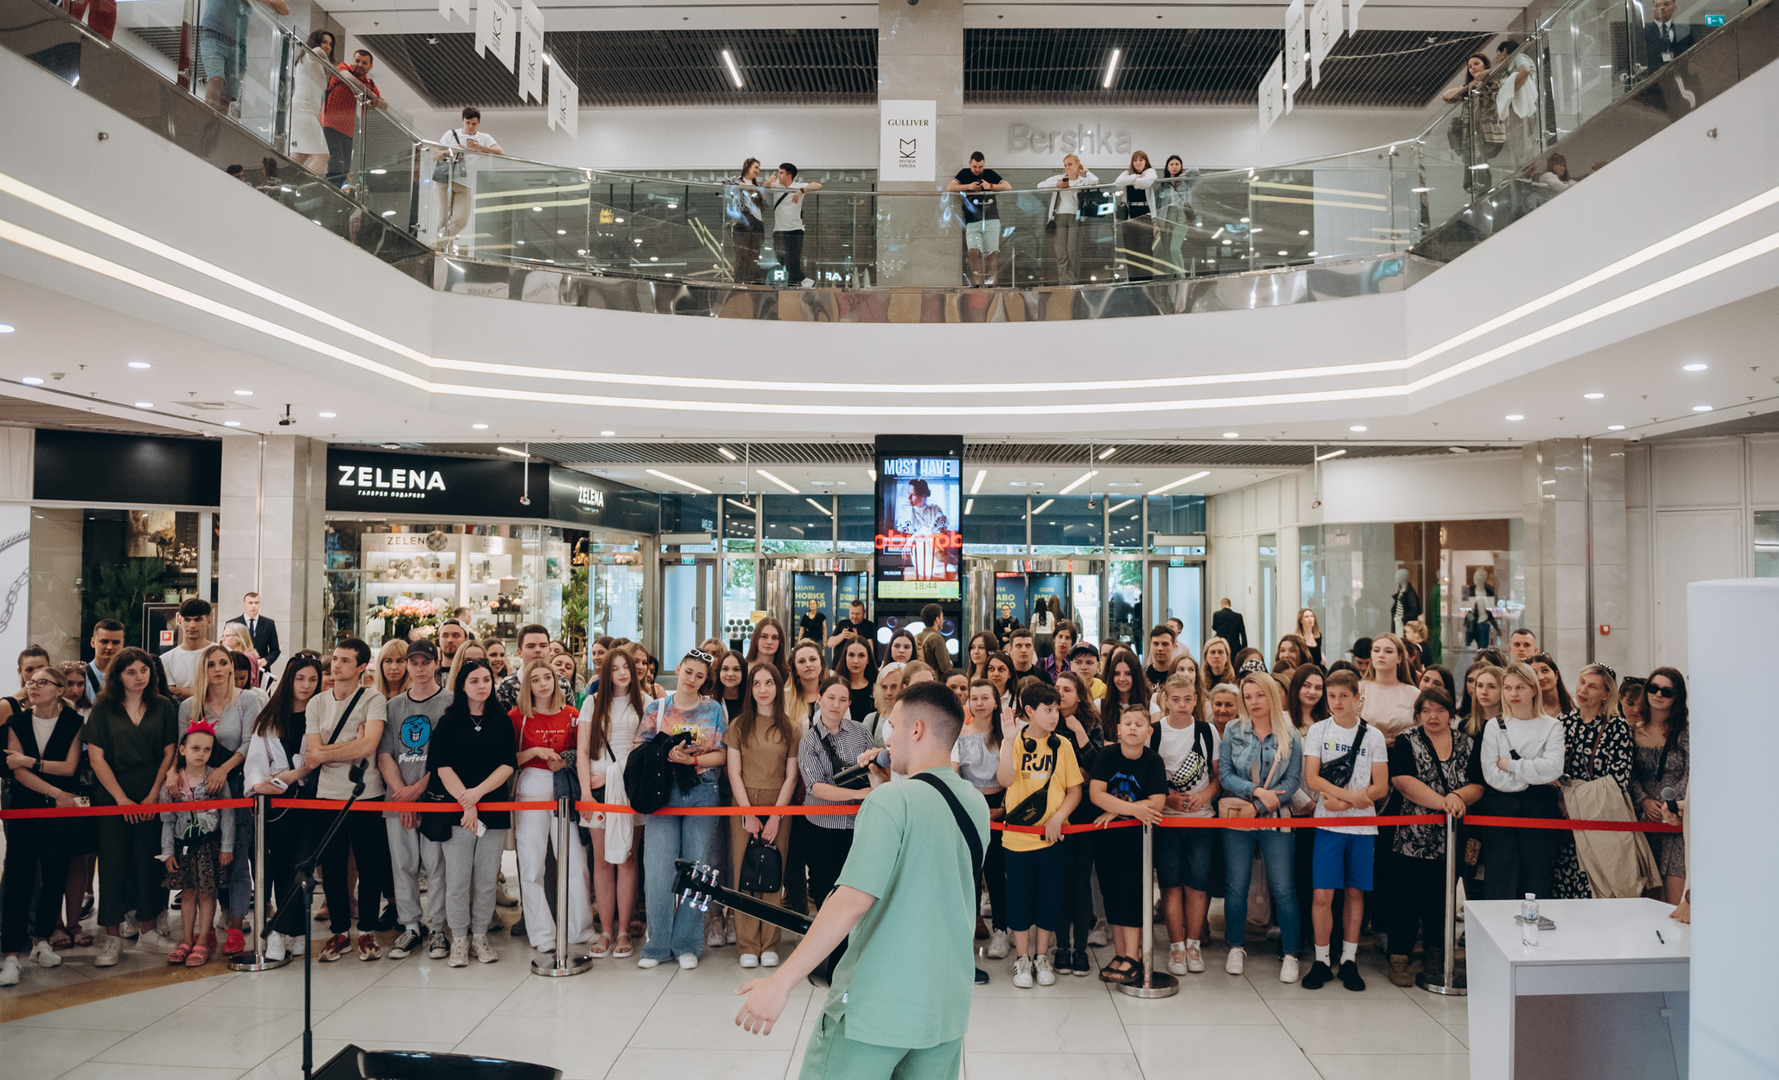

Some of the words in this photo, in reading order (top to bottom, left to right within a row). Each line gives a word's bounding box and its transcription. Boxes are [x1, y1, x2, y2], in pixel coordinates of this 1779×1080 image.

[887, 119, 929, 127] GULLIVER
[1009, 123, 1132, 155] Bershka
[884, 459, 918, 475] MUST
[920, 459, 951, 475] HAVE
[338, 465, 446, 491] ZELENA
[578, 486, 604, 508] ZELENA
[387, 536, 426, 546] ZELEN
[914, 582, 937, 590] 18:44
[795, 592, 825, 600] НОВИХ
